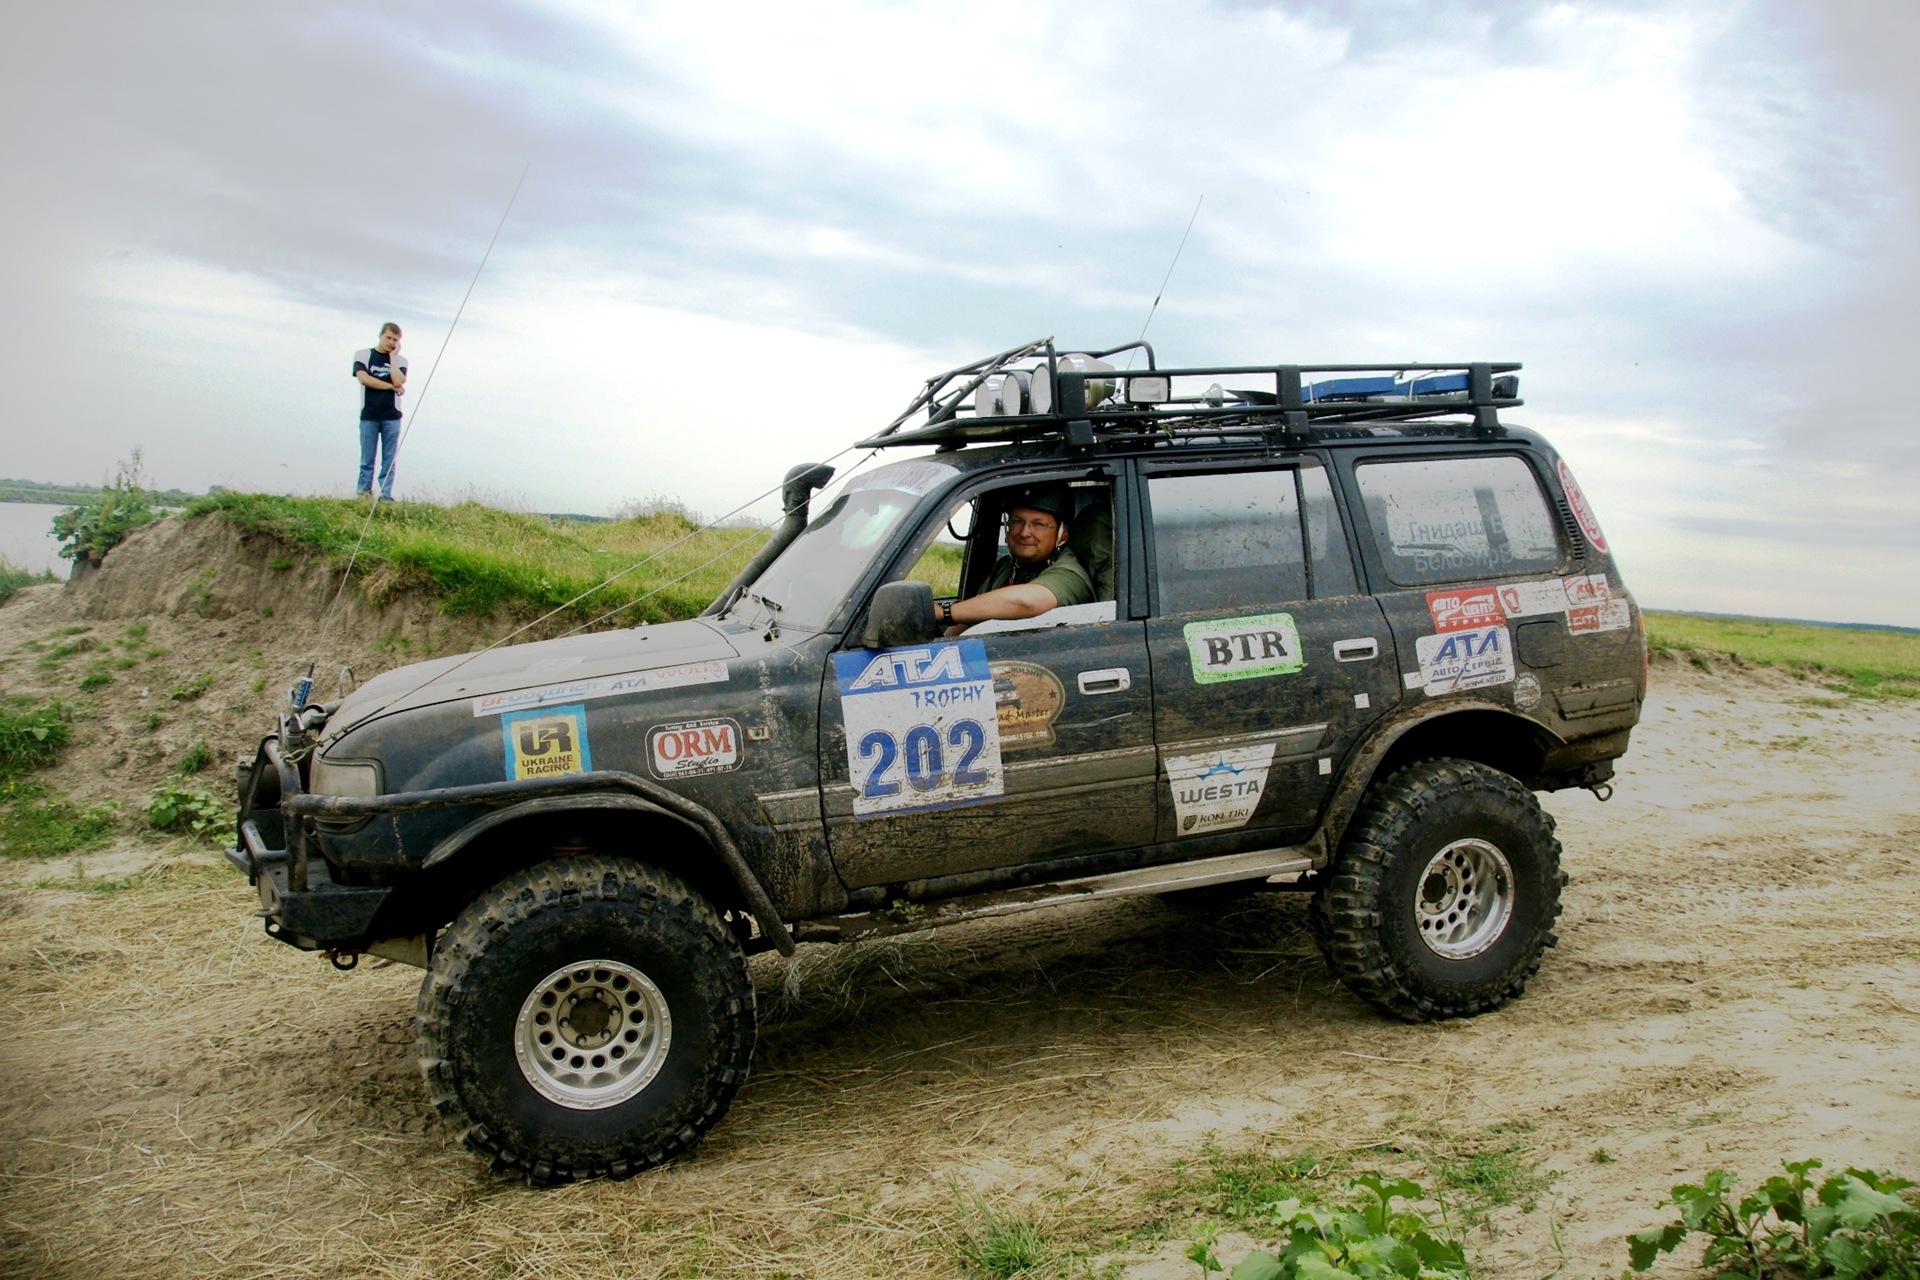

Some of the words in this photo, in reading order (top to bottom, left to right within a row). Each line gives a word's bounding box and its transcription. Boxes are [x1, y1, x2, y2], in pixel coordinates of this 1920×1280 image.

[1202, 631, 1288, 666] BTR
[910, 685, 985, 709] TROPHY
[657, 726, 732, 761] ORM
[522, 754, 574, 768] UKRAINE
[527, 763, 571, 775] RACING
[675, 756, 719, 769] Studio
[858, 718, 989, 800] 202
[1179, 780, 1260, 804] WESTA
